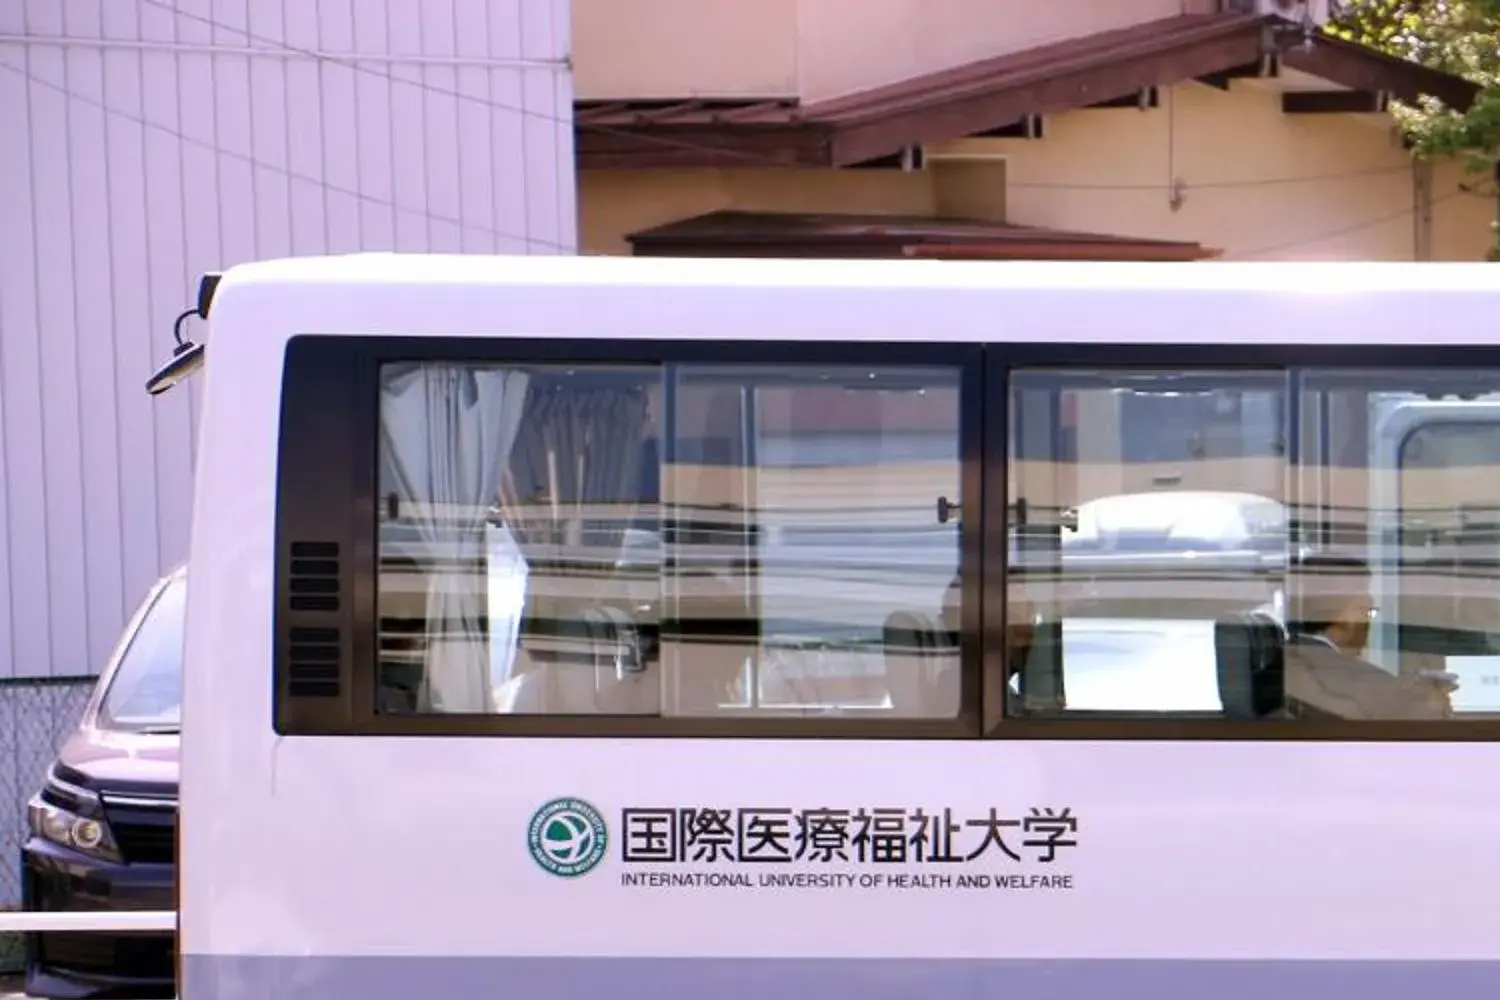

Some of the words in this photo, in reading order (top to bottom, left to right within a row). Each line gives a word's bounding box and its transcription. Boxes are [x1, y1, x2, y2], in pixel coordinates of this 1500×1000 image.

[621, 807, 1078, 863] 国際医療福祉大学
[621, 871, 754, 887] INTERNATIONAL
[758, 872, 856, 888] UNIVERSITY
[859, 872, 884, 888] OF
[887, 873, 951, 889] HEALTH
[955, 873, 992, 889] AND
[993, 873, 1073, 889] WELFARE
